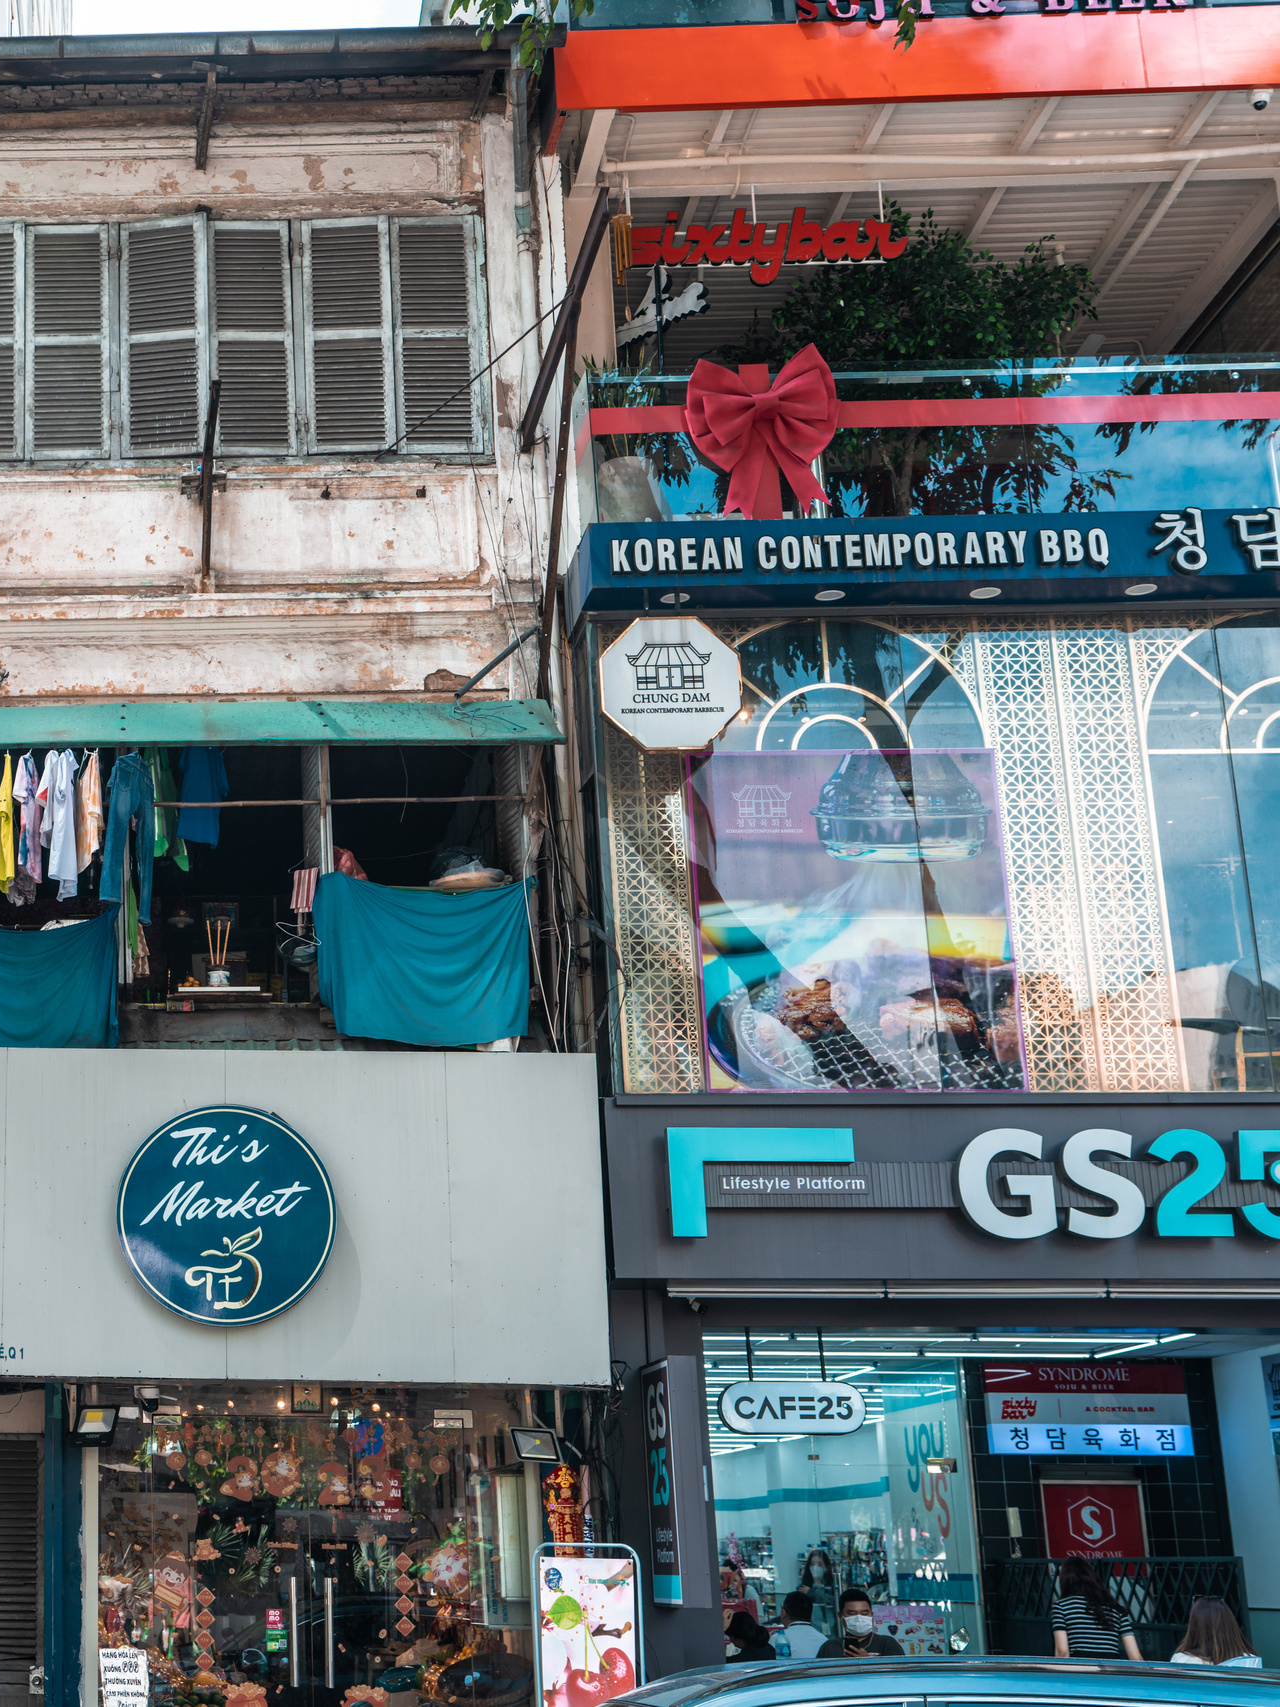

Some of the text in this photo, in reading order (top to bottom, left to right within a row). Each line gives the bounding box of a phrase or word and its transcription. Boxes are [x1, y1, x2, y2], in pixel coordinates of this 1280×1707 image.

[631, 207, 908, 285] sixtybar
[611, 528, 1111, 573] KOREAN CONTEMPORARY BBQ
[632, 692, 711, 704] CHUNG DAM
[170, 1124, 270, 1168] Thi's
[722, 1175, 867, 1194] Lifestyle Platform
[139, 1181, 312, 1226] Market
[20, 1347, 24, 1359] 1
[1038, 1367, 1131, 1382] SYNDROME
[647, 1380, 667, 1442] GS
[733, 1394, 854, 1421] CAFE25
[1001, 1396, 1038, 1418] sixty
[1001, 1407, 1028, 1420] bar
[1009, 1427, 1177, 1451] 청담육화점
[650, 1446, 670, 1507] 25
[1081, 1505, 1103, 1540] S
